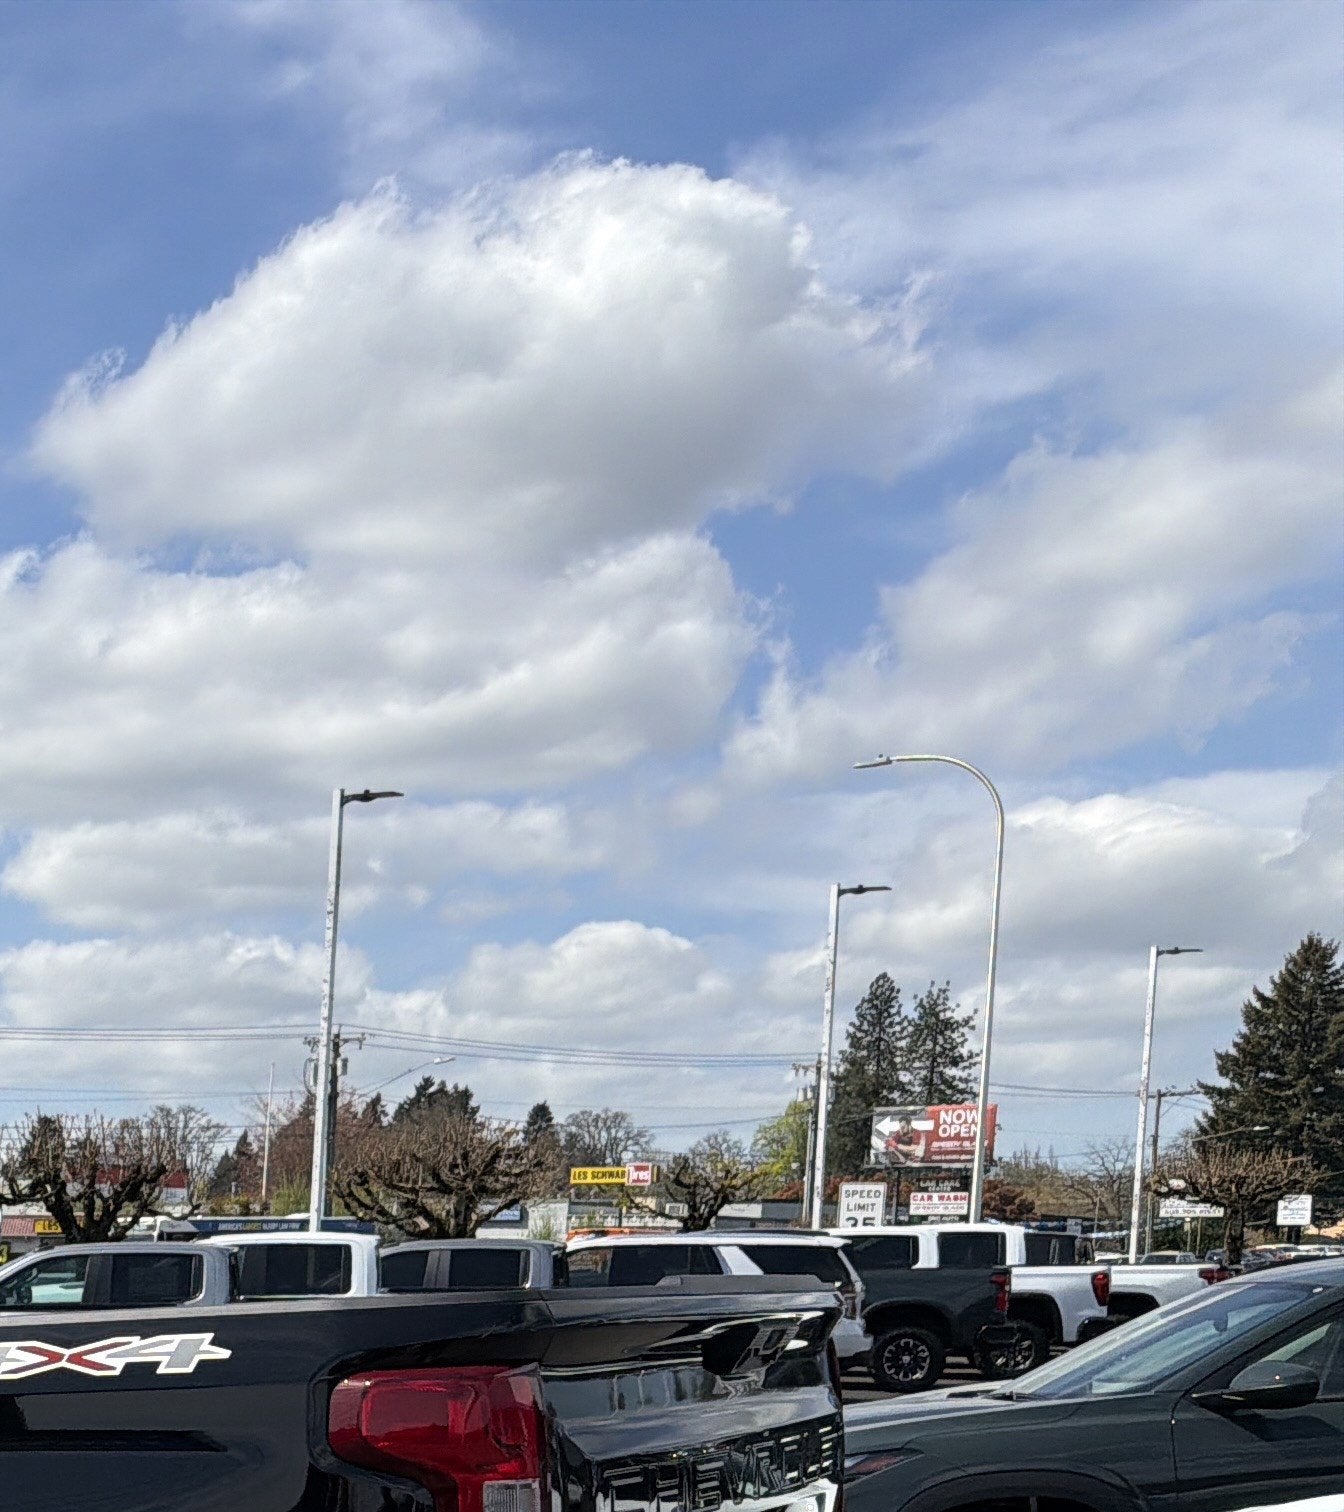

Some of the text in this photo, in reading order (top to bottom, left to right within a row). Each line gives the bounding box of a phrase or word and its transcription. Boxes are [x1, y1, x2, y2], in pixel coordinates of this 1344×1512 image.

[939, 1109, 978, 1125] NOW
[572, 1169, 588, 1181] LES
[590, 1170, 627, 1181] SCHWAB
[844, 1189, 882, 1199] SPEED
[911, 1194, 968, 1202] CAR WASH
[846, 1202, 877, 1213] LIMIT
